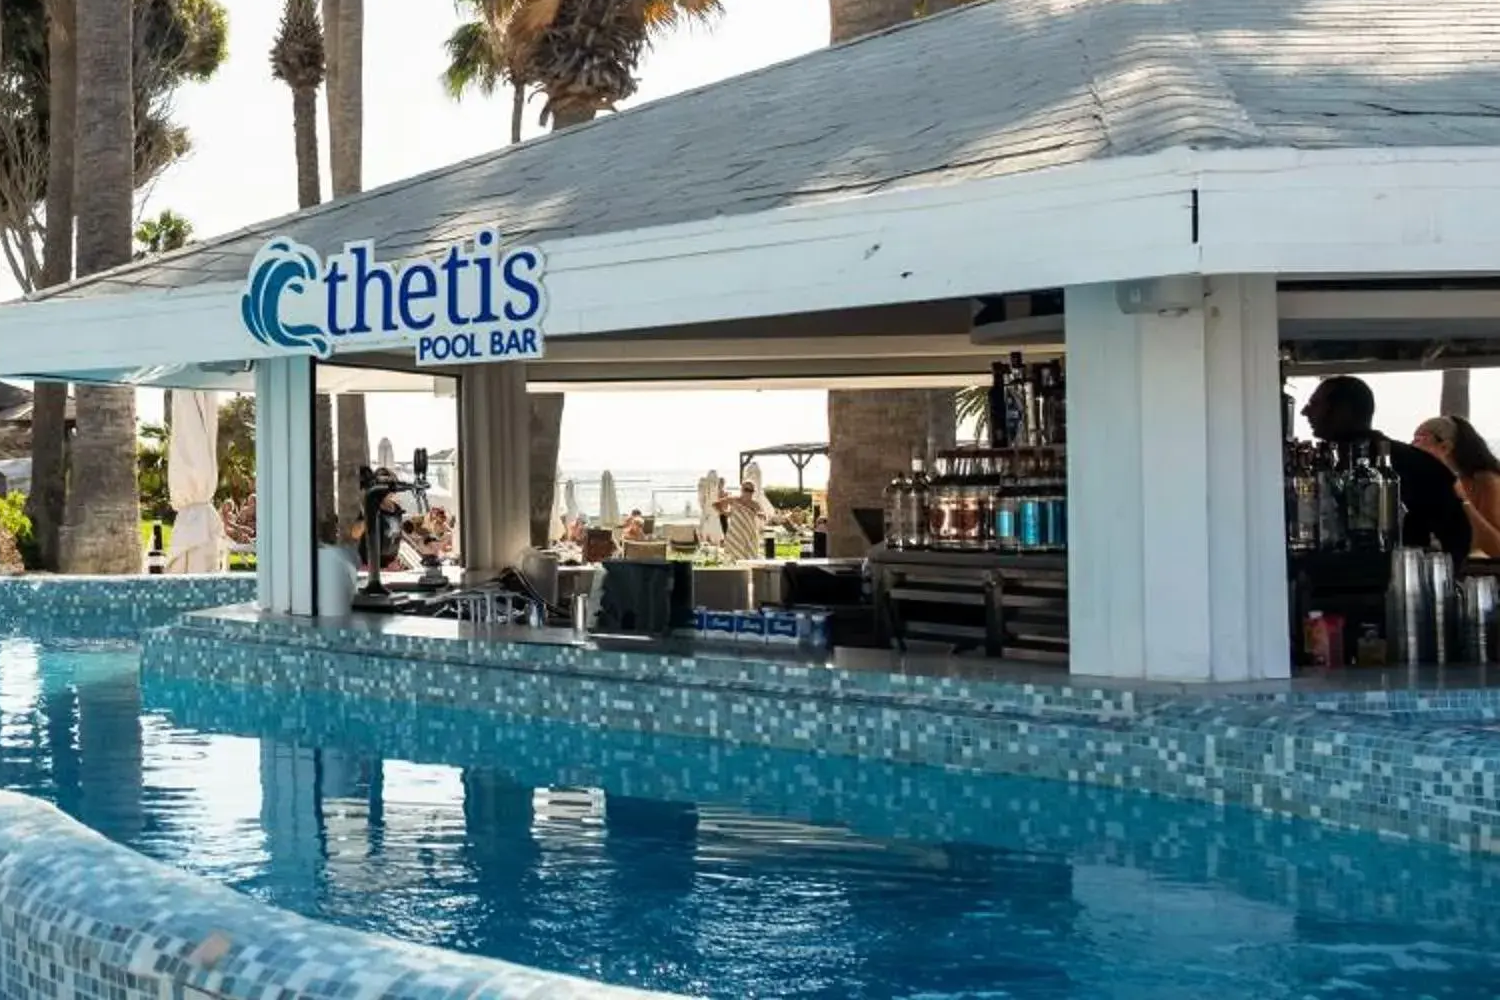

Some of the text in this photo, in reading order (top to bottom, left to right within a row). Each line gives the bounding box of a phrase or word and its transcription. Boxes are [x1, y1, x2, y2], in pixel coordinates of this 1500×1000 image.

[323, 231, 539, 336] thetis
[419, 327, 537, 361] POOL BAR
